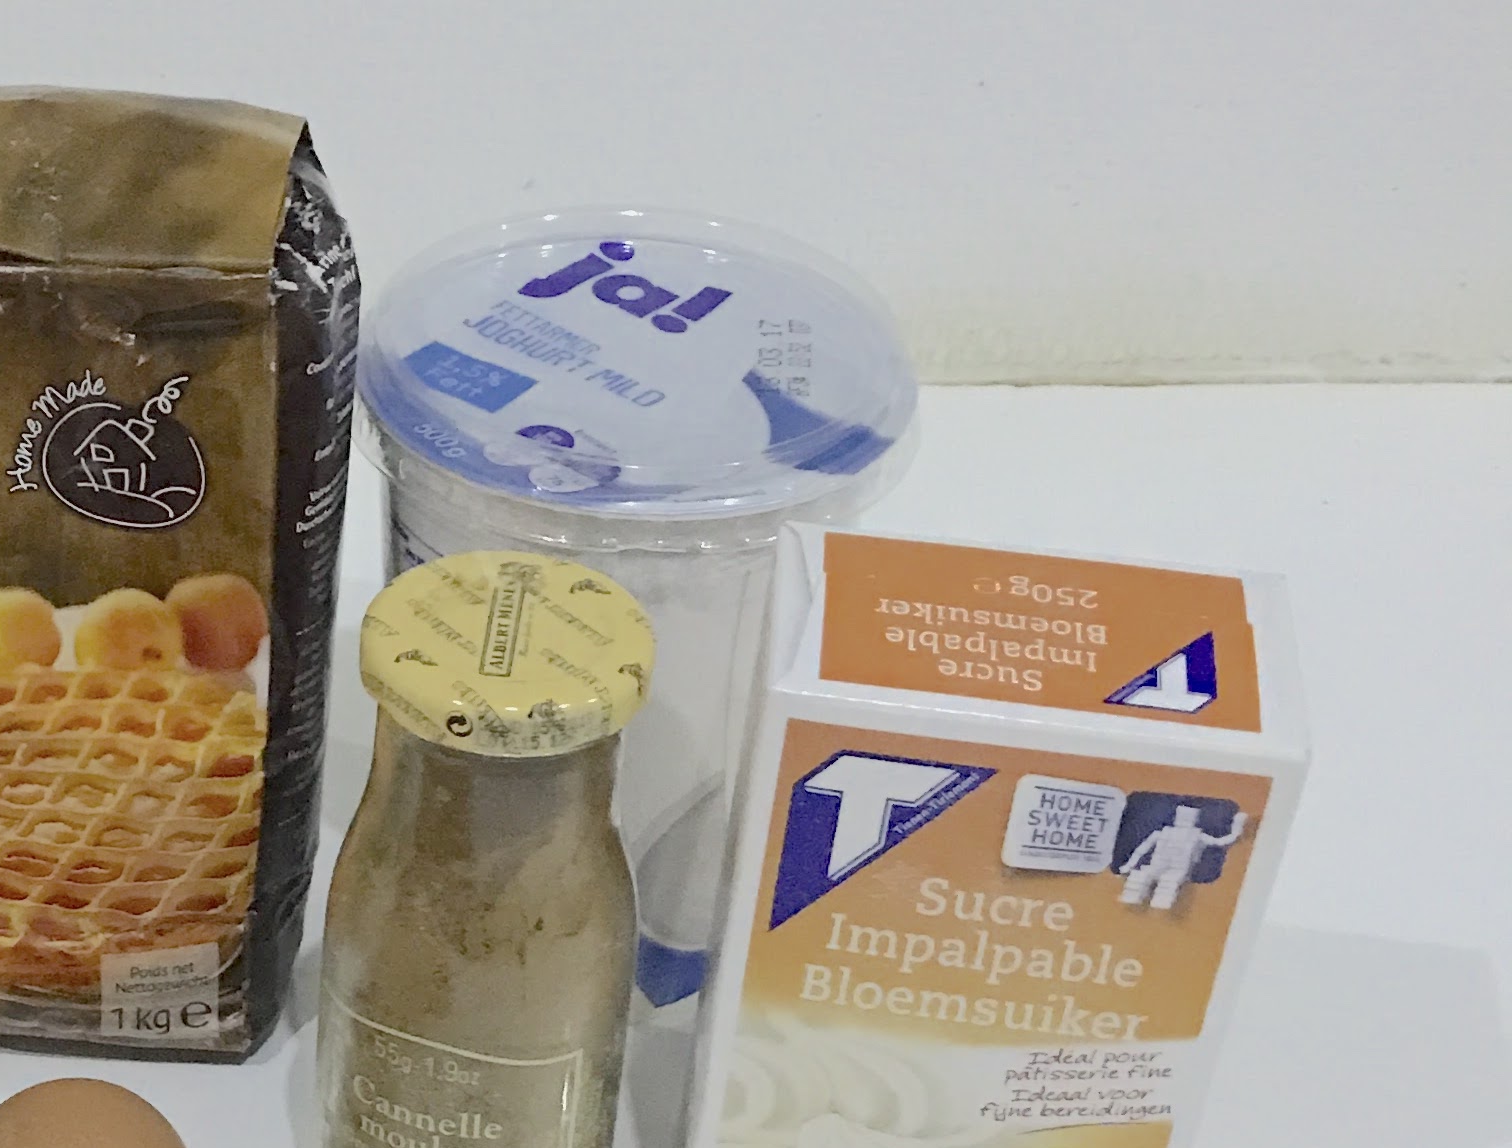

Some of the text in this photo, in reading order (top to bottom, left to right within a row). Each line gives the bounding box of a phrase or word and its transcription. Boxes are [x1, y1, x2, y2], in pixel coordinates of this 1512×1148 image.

[518, 240, 733, 334] ja!
[491, 299, 601, 353] FETTARMER
[462, 315, 667, 407] JOGHURT MILD
[6, 368, 108, 493] Home Made
[1008, 574, 1099, 610] 250g
[489, 618, 511, 671] ALBERT
[874, 596, 1108, 645] Bloemsuiker
[884, 625, 1098, 673] Impalpable
[937, 658, 1044, 692] Sucre
[1027, 809, 1109, 833] SWEET
[1040, 792, 1107, 817] HOME
[1031, 827, 1100, 850] HOME
[915, 875, 1075, 933] Sucre
[824, 911, 1144, 989] Impalpable
[798, 962, 1148, 1042] Bloemsuiker
[1003, 1064, 1174, 1085] pâtisserie fine
[1102, 1051, 1164, 1070] pour
[352, 1073, 504, 1140] Cannelle
[1011, 1086, 1156, 1103] Ideaal voor
[1037, 1100, 1173, 1121] bereidingen
